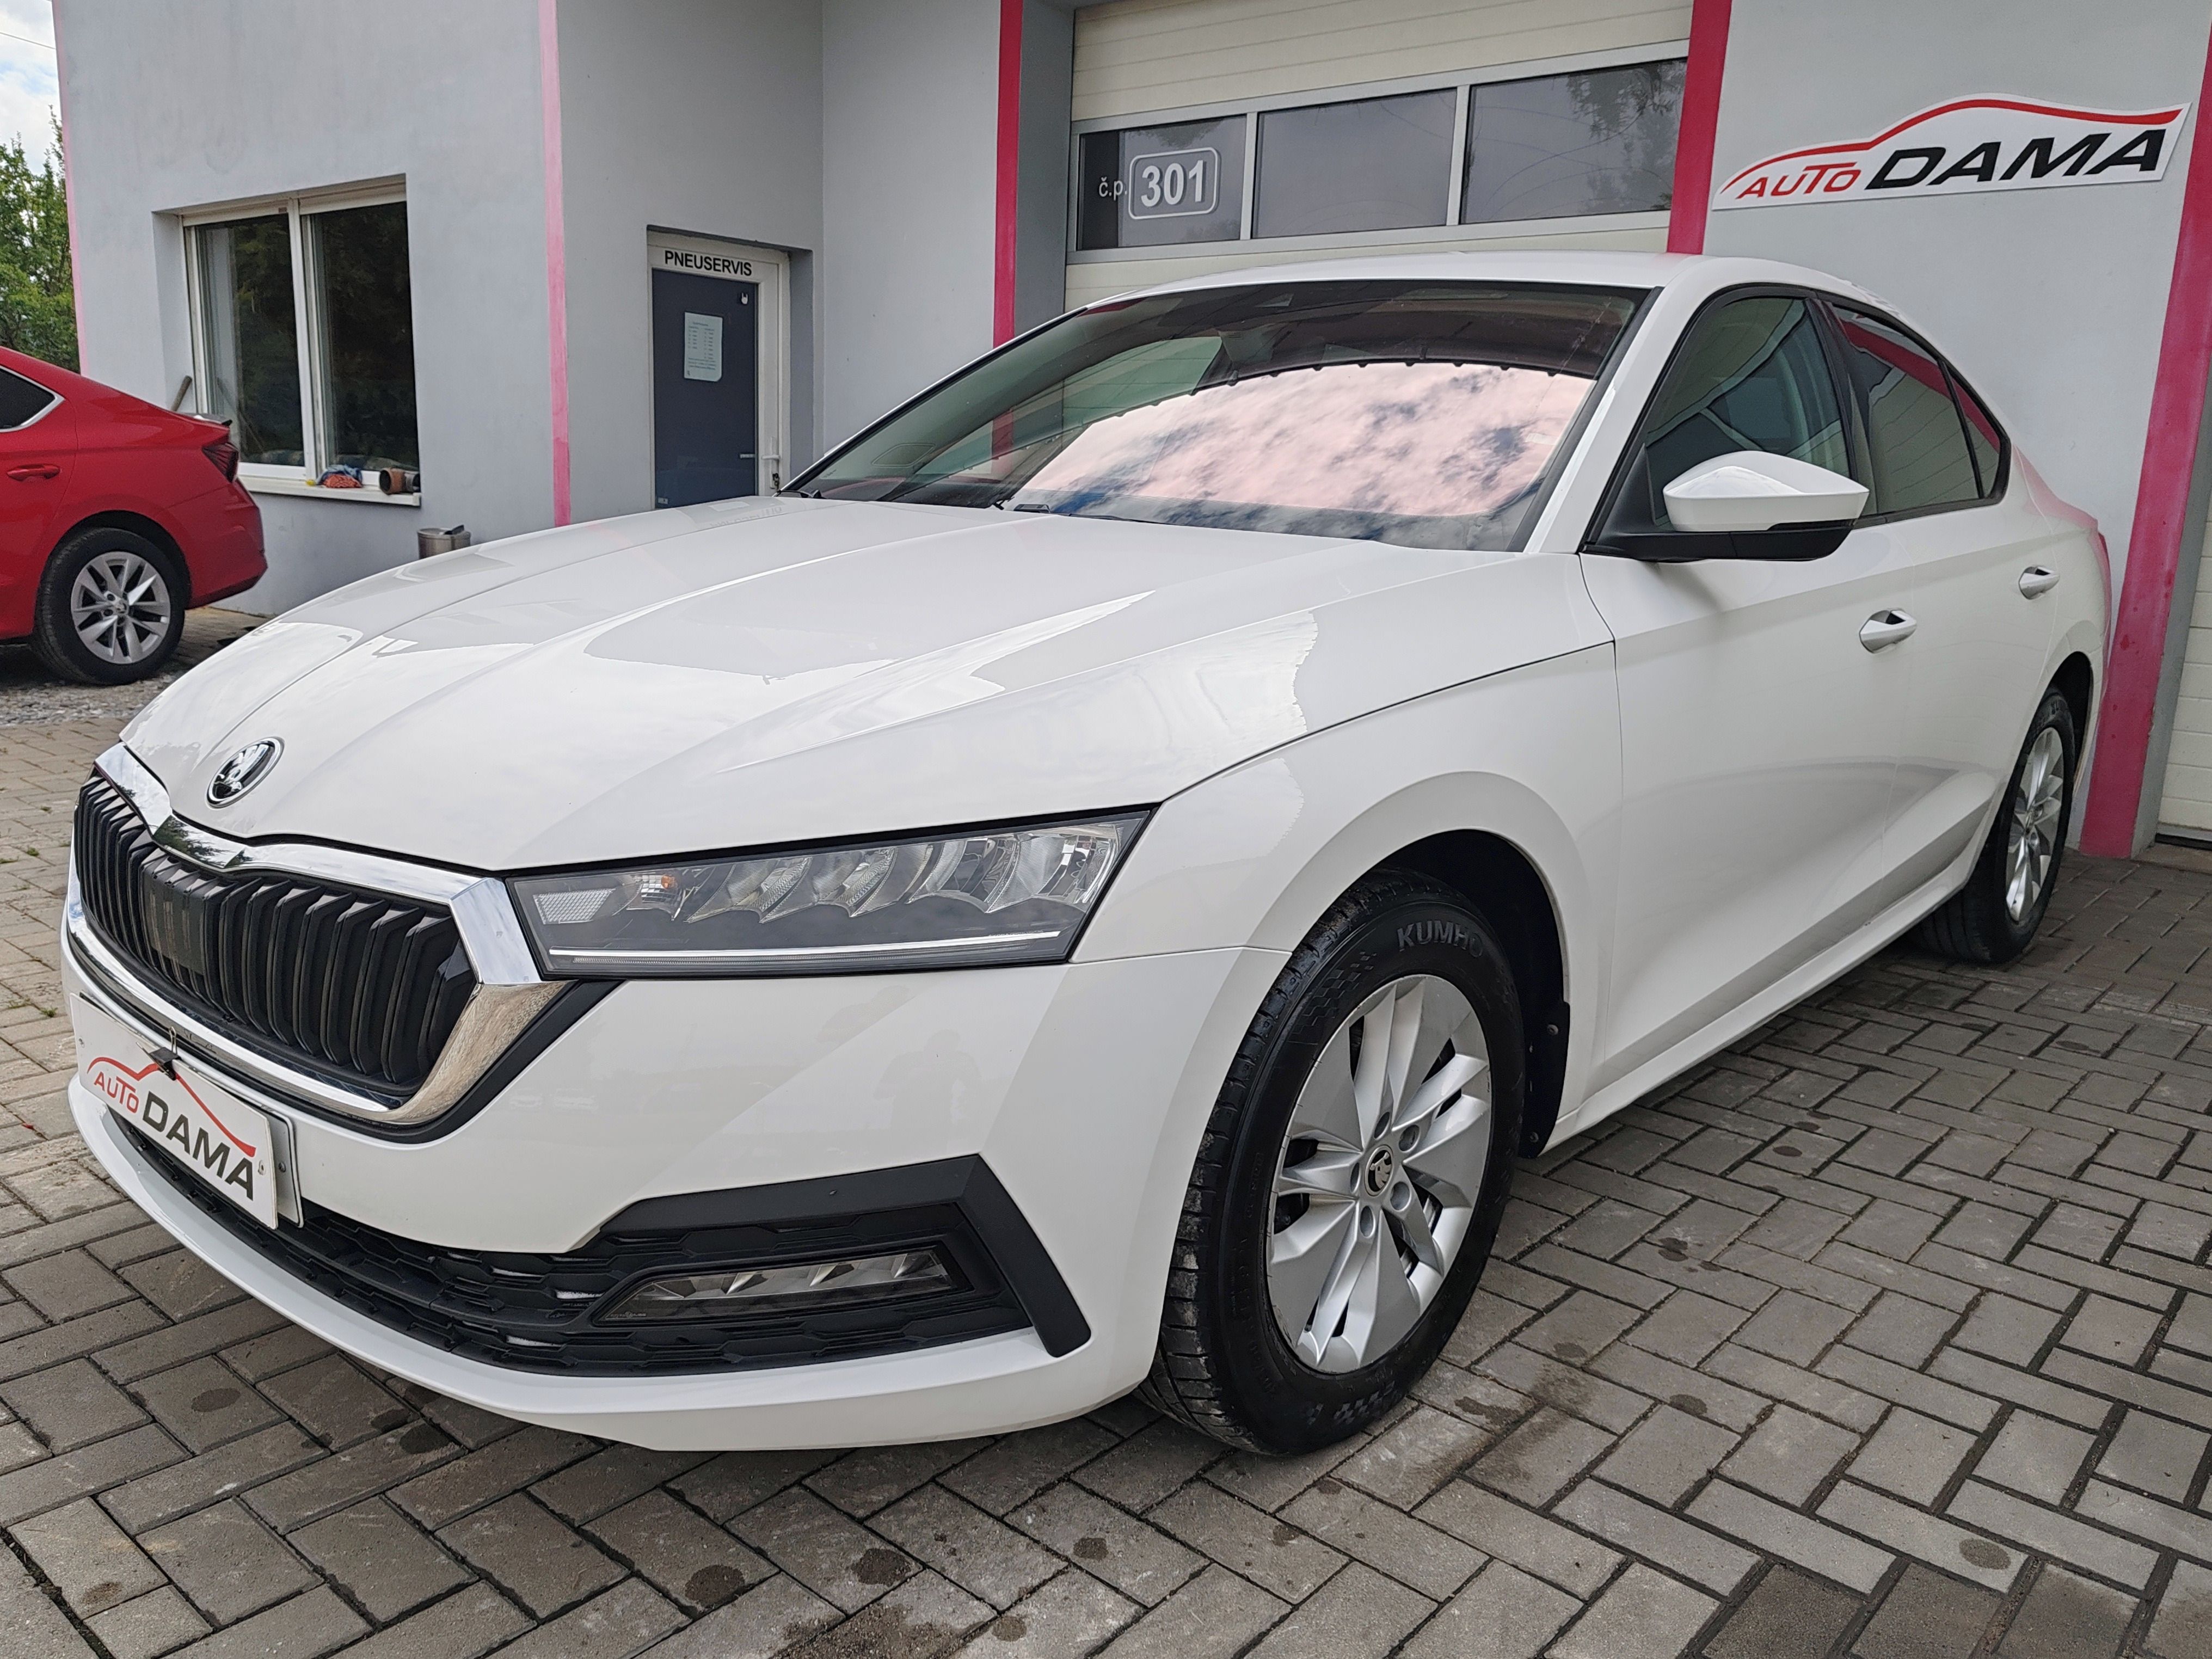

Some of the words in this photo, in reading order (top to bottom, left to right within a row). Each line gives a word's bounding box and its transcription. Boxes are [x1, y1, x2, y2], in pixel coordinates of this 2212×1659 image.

[1098, 176, 1128, 201] č.p.
[1140, 159, 1204, 207] 301
[1736, 161, 1861, 199] AUTO
[1864, 128, 2167, 191] DAMA
[664, 250, 753, 276] PNEUSERVIS
[1396, 919, 1484, 958] KUMHO
[94, 1071, 140, 1114] AUTO
[142, 1090, 254, 1201] DAMA
